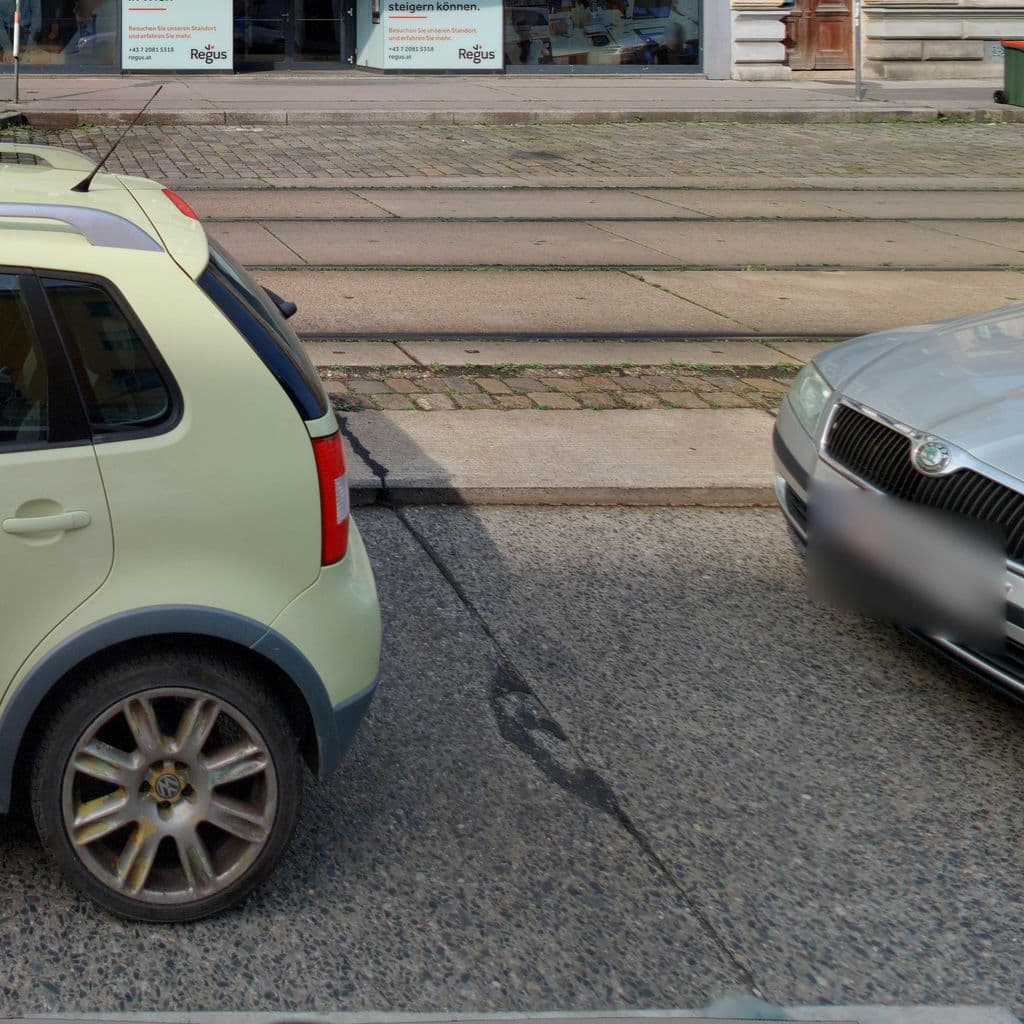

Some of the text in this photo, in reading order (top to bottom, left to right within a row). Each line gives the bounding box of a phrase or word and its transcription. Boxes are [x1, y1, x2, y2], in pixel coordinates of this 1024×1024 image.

[389, 2, 480, 13] steigern können.
[190, 48, 227, 64] Regus
[459, 48, 495, 64] Regus
